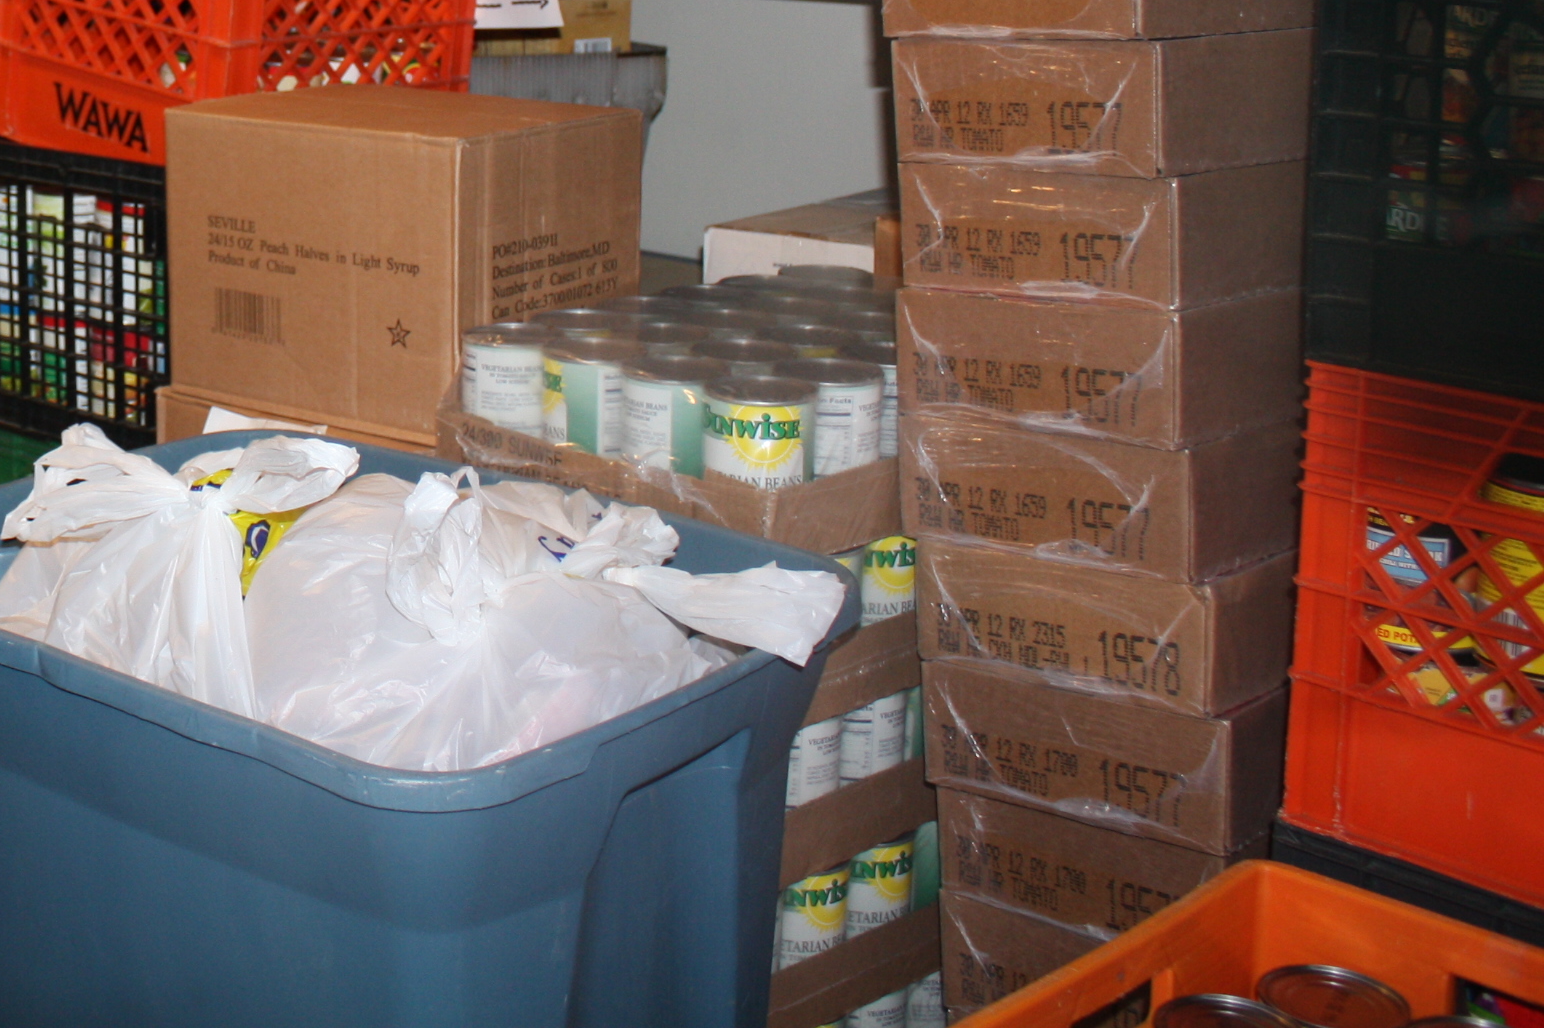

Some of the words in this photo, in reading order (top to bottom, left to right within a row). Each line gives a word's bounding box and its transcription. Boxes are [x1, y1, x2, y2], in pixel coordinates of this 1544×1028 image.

[53, 81, 149, 154] WAWA
[956, 101, 970, 124] 12
[999, 102, 1028, 127] 1659
[960, 127, 1004, 152] TOMATO
[207, 215, 256, 234] SEVILLE
[207, 232, 234, 248] 24/15
[238, 237, 253, 249] OZ
[260, 240, 289, 256] Peach
[295, 244, 330, 262] Halves
[336, 250, 347, 264] in
[352, 253, 381, 271] Light
[386, 258, 420, 277] Syrup
[966, 227, 981, 251] 12
[1010, 230, 1041, 256] 1659
[208, 250, 244, 267] Product
[250, 256, 260, 270] of
[266, 259, 296, 275] China
[969, 253, 1014, 280] TOMATO
[492, 280, 528, 300] Number
[532, 275, 544, 290] of
[587, 262, 597, 276] of
[492, 304, 510, 320] Can
[964, 358, 979, 382] 12
[1010, 363, 1041, 389] 1659
[645, 400, 668, 411] BEANS
[967, 384, 1013, 412] TOMATO
[968, 486, 984, 511] 12
[1015, 492, 1048, 519] 1659
[971, 512, 1019, 542] TOMATO
[987, 613, 1003, 638] 12
[996, 737, 1012, 763] 12
[1001, 763, 1049, 797] TOMATO
[1007, 850, 1023, 876] 12
[1010, 876, 1058, 912] TOMATO
